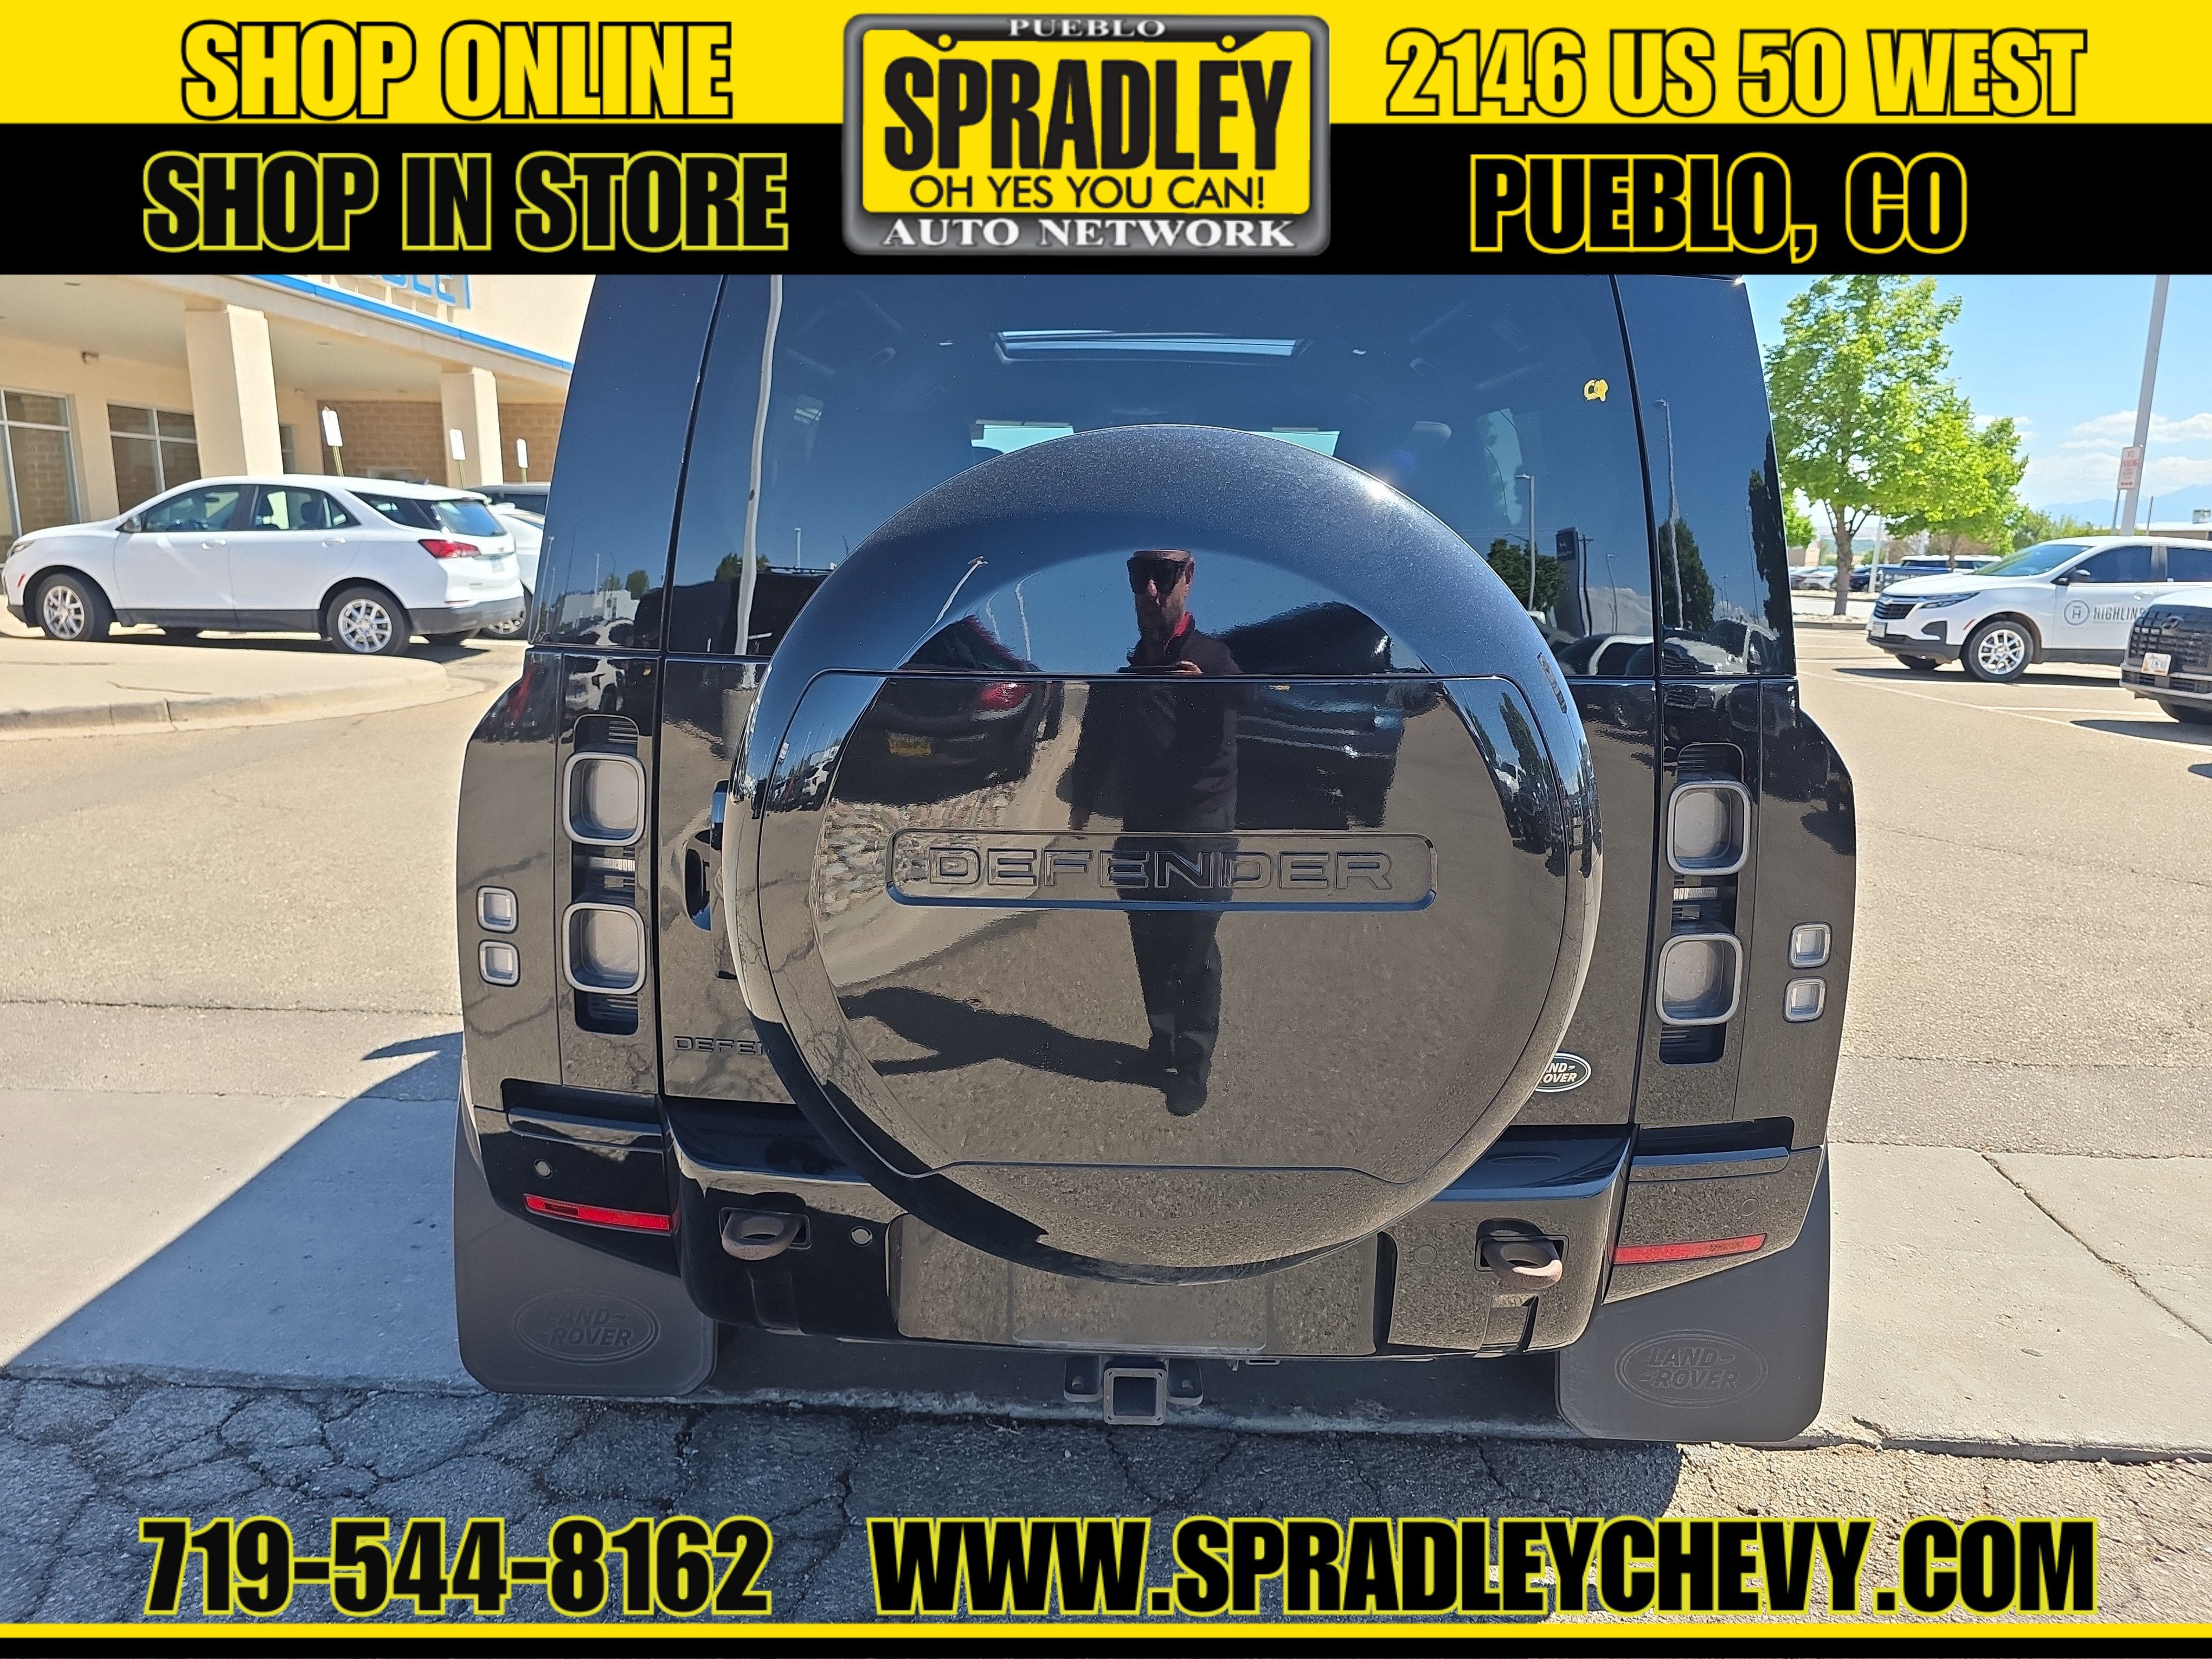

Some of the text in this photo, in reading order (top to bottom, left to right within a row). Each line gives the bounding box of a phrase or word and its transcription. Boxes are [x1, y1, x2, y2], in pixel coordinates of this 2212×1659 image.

[928, 846, 1393, 890] DEFENDER
[1540, 1072, 1578, 1083] OVER
[542, 1306, 611, 1324] LAND
[549, 1328, 633, 1346] ROVER
[1648, 1347, 1718, 1367] LAND
[1654, 1368, 1740, 1388] ROVER
